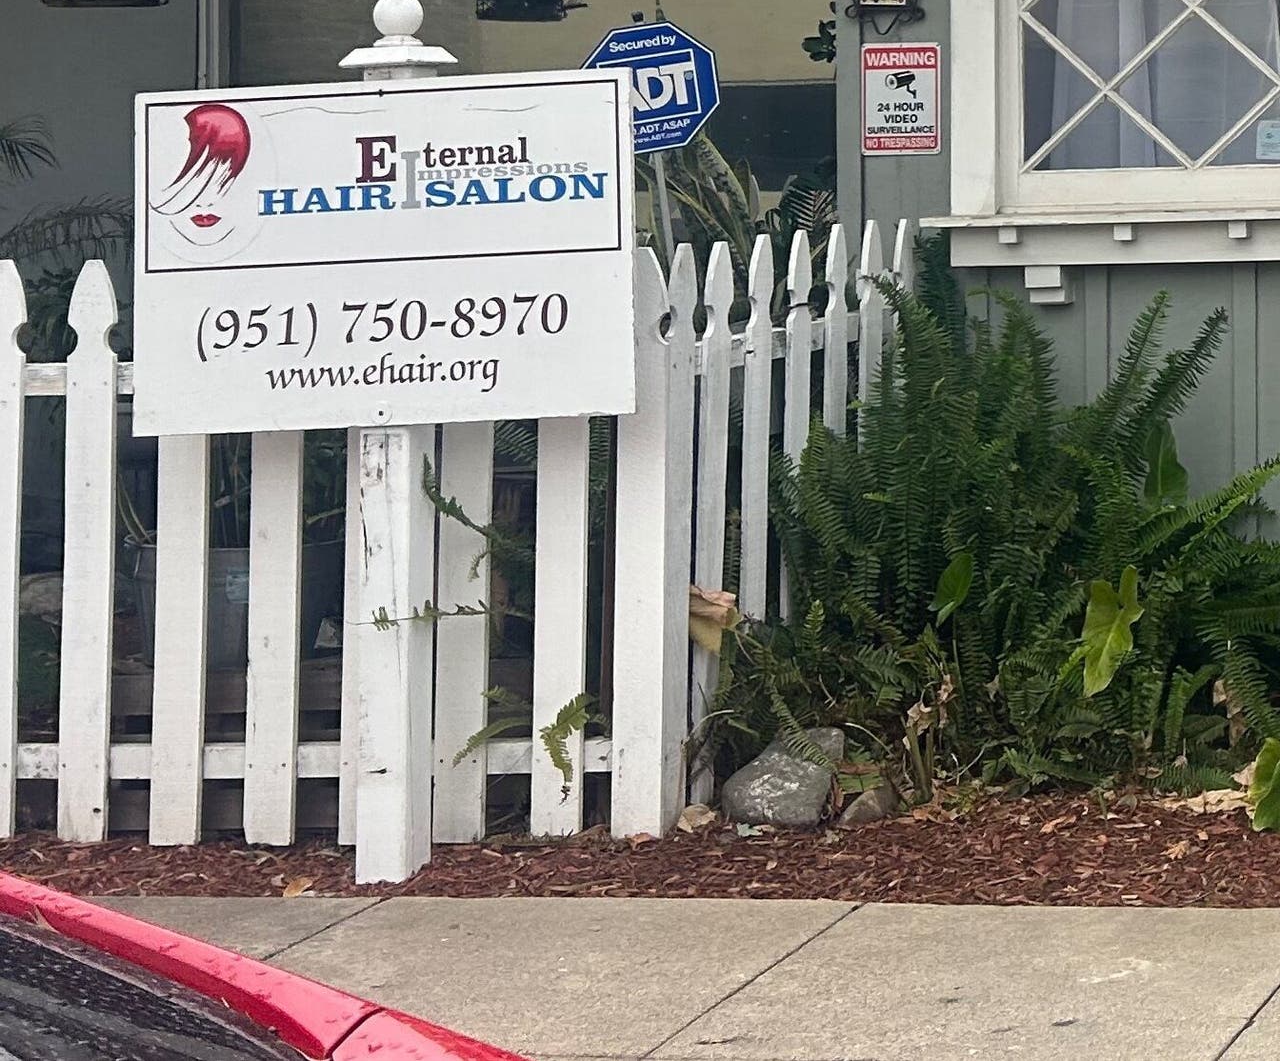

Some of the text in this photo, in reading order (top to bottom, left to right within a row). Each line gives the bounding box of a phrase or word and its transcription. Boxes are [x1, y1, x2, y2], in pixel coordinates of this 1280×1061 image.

[609, 34, 677, 53] Secured by
[865, 51, 936, 67] WARNING
[877, 102, 925, 113] 24 HOUR
[884, 114, 918, 124] VIDEO
[867, 125, 935, 135] SURVEILLANCE
[866, 138, 936, 149] NO TRESPASSING
[355, 135, 530, 184] Eternal
[258, 172, 609, 217] HAIR SALON
[196, 292, 569, 363] (951) 750-8970
[265, 352, 500, 393] www.ehair.org
